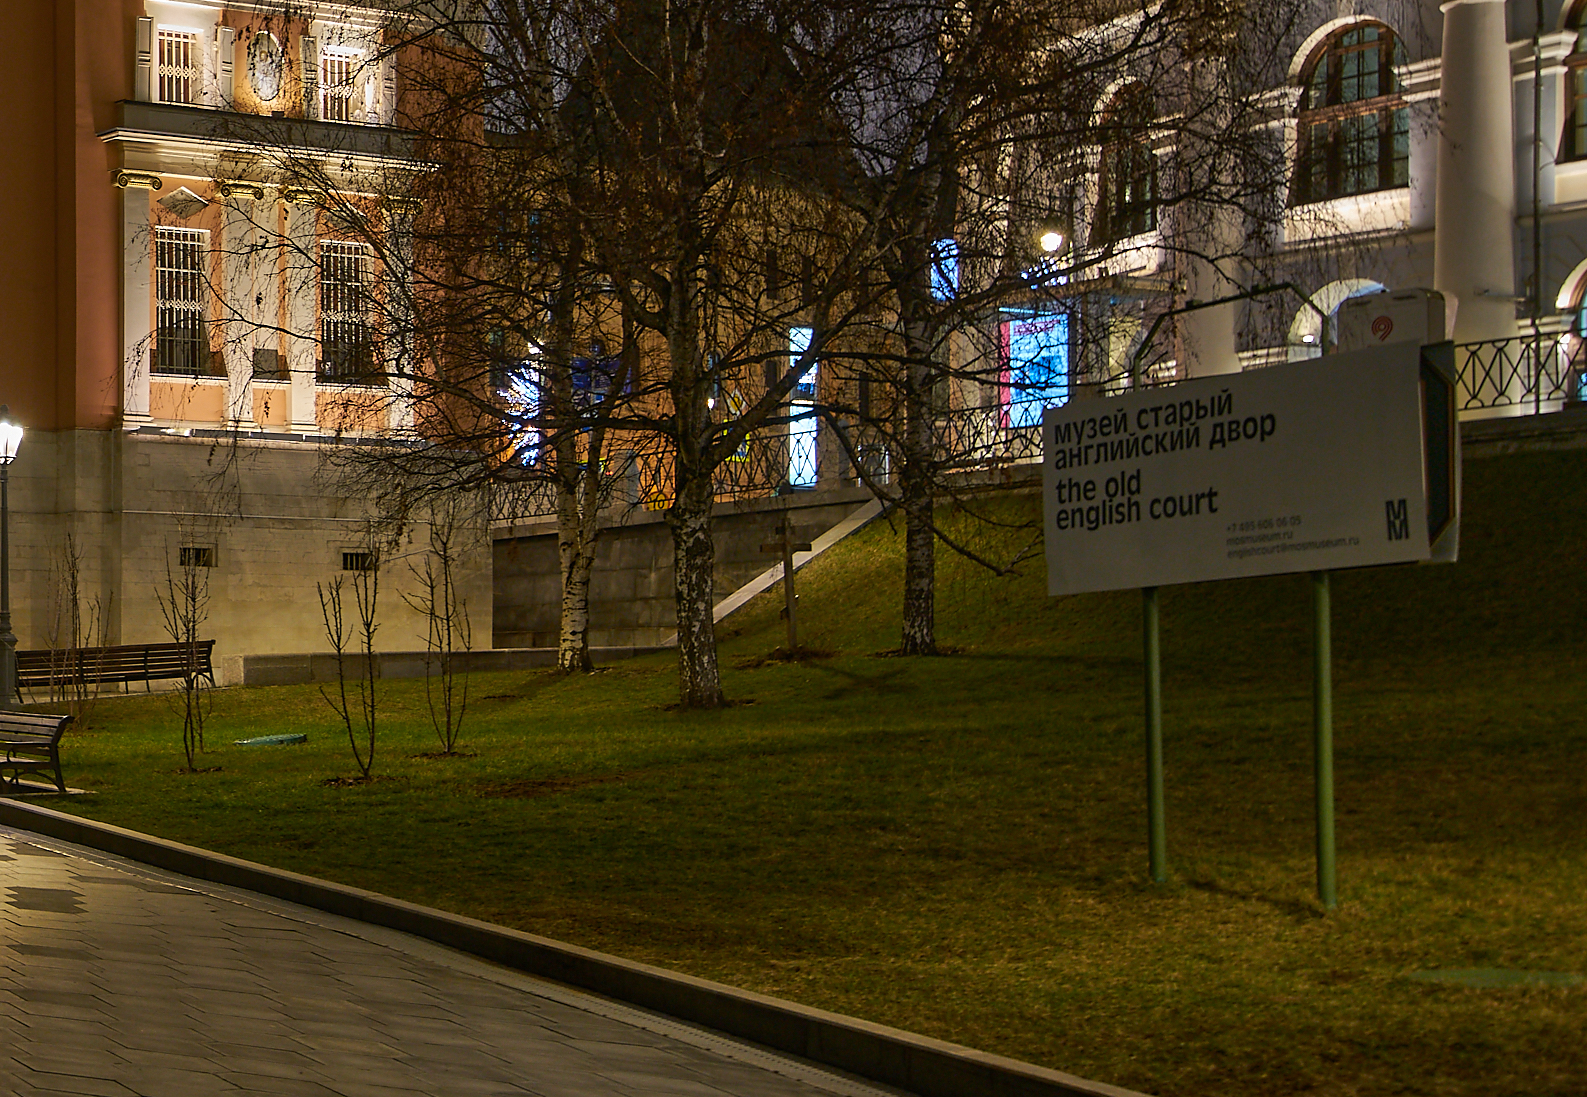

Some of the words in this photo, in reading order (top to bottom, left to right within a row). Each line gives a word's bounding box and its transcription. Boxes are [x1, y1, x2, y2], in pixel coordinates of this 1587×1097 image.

[1054, 408, 1128, 446] музей
[1136, 389, 1233, 430] старый
[1054, 421, 1201, 470] английский
[1208, 413, 1276, 450] двор
[1055, 478, 1097, 504] the
[1104, 468, 1141, 498] old
[1056, 497, 1141, 531] english
[1149, 487, 1218, 520] court
